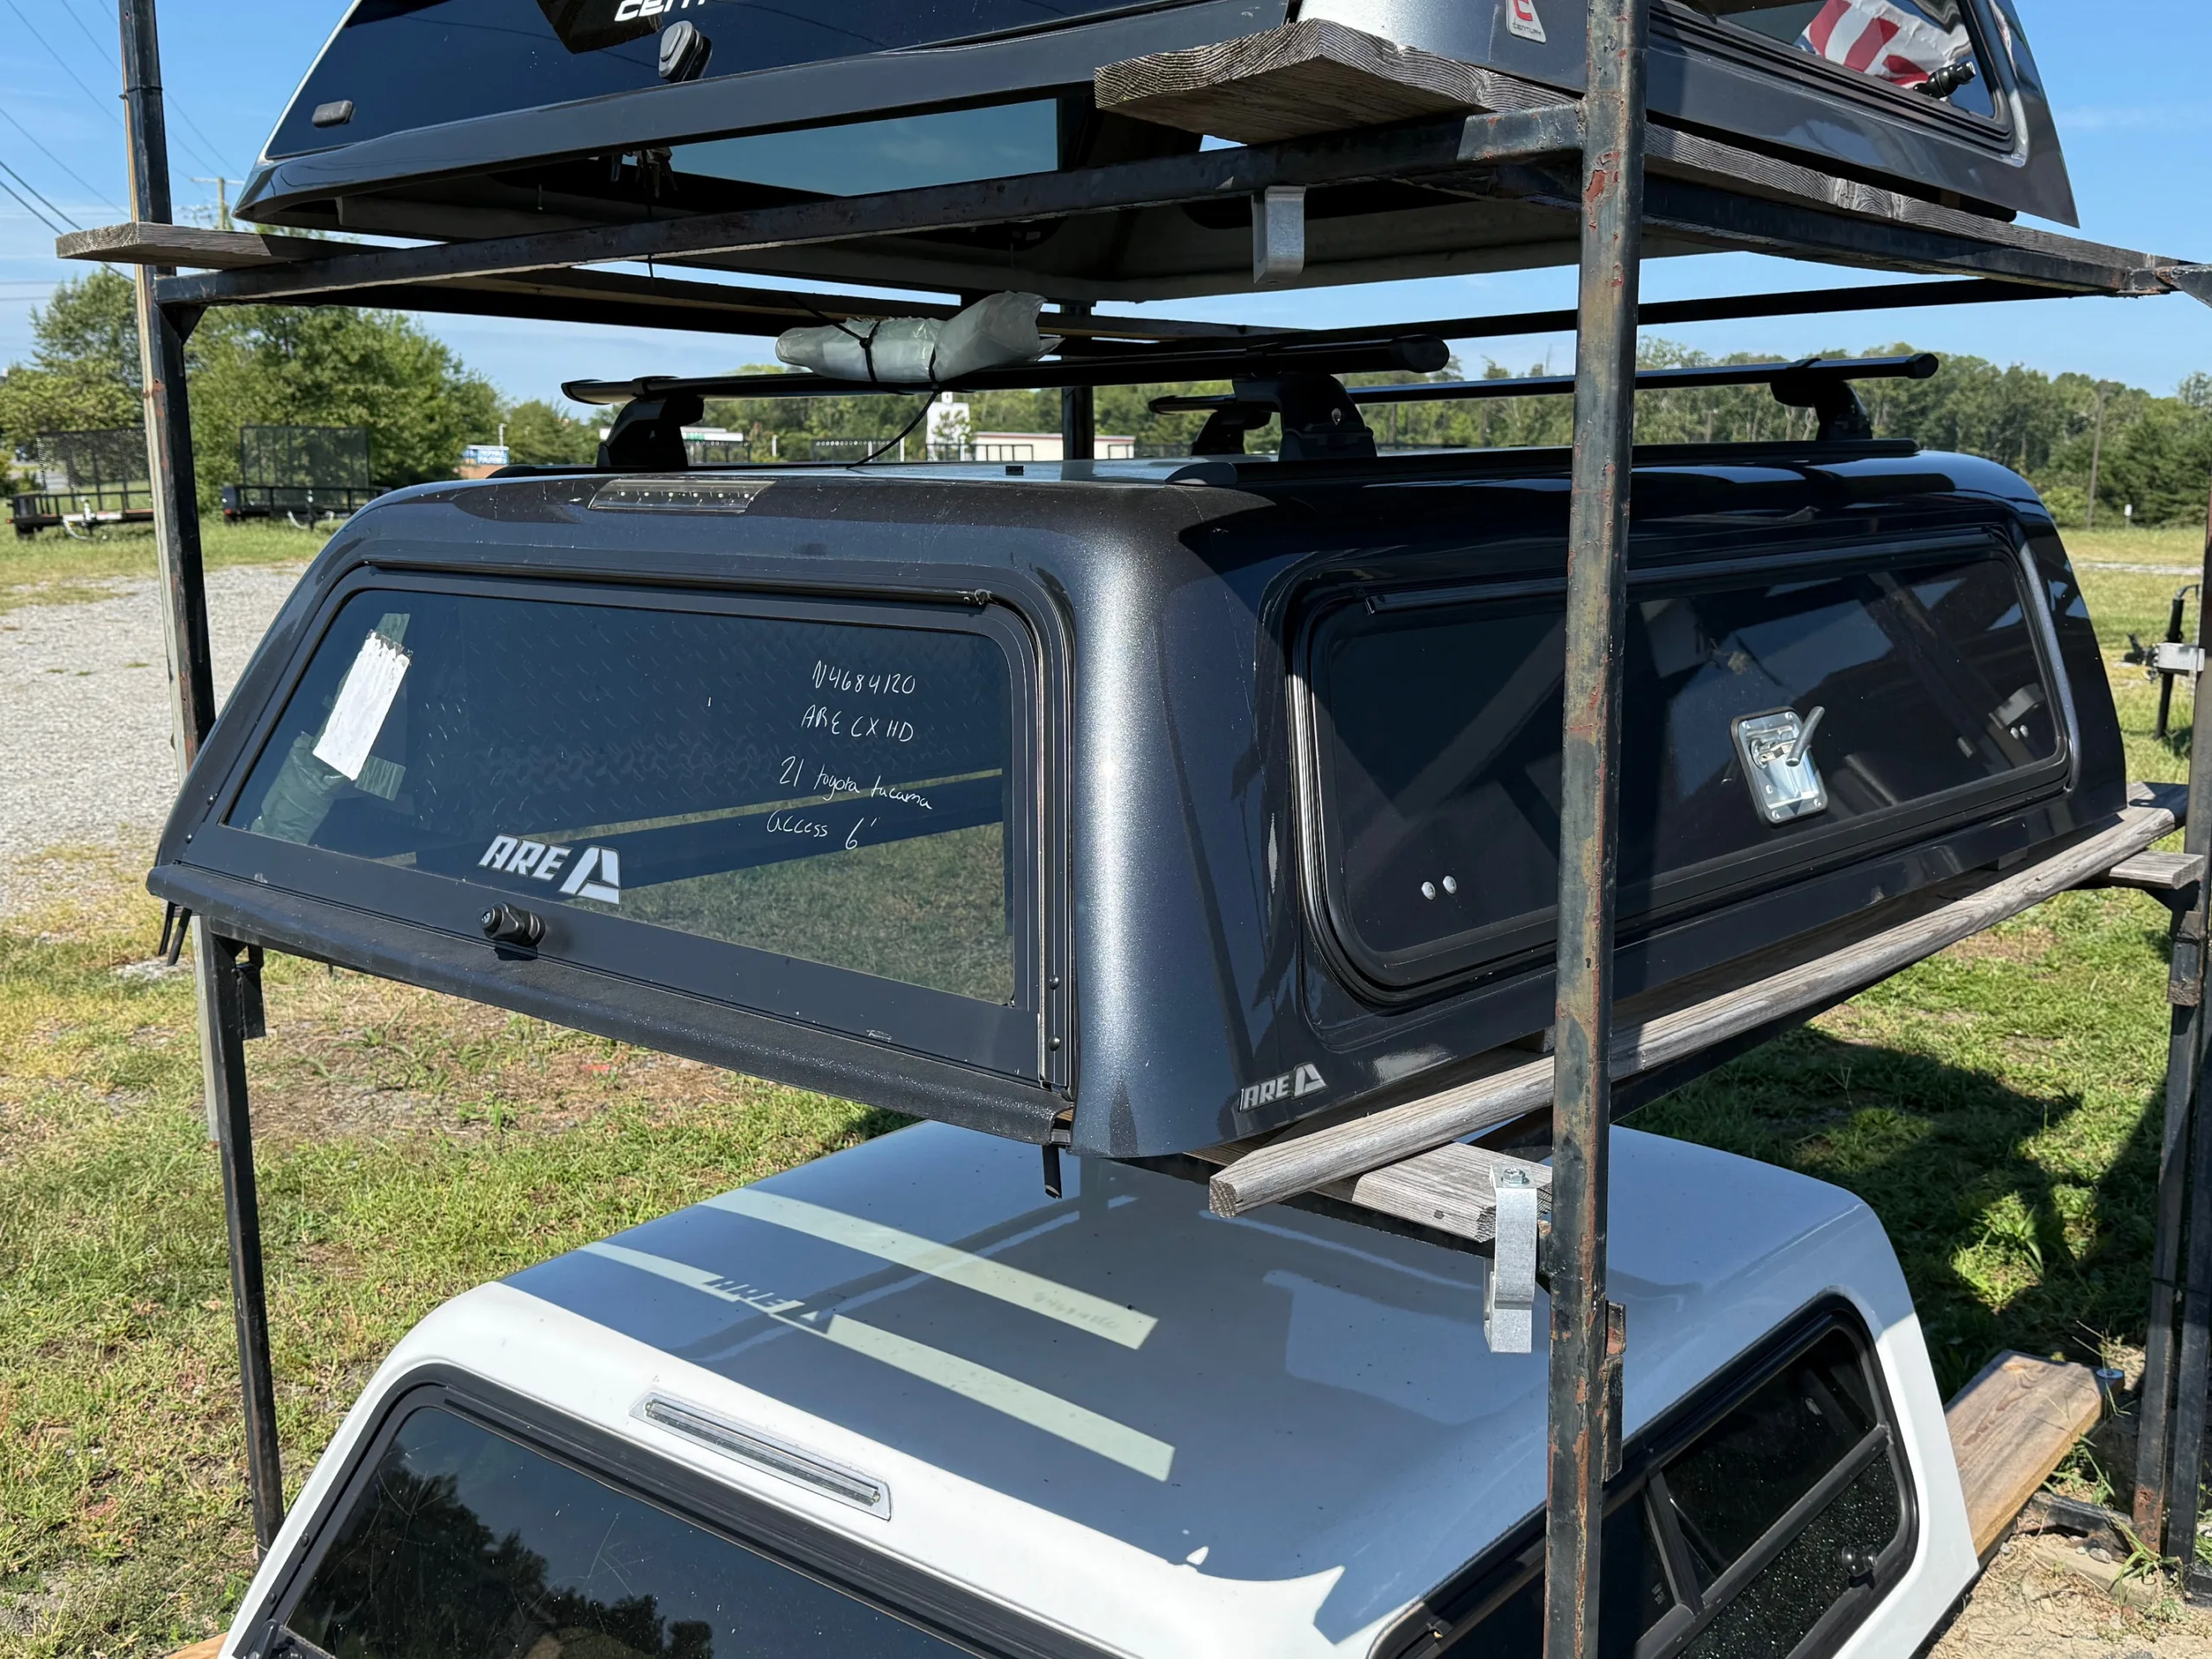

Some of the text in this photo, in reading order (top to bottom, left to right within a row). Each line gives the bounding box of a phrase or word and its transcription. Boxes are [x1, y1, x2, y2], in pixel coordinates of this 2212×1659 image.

[812, 659, 916, 694] N4684120
[800, 704, 914, 741] ARE CX HD
[779, 755, 804, 787] 21
[477, 835, 574, 882] ARE
